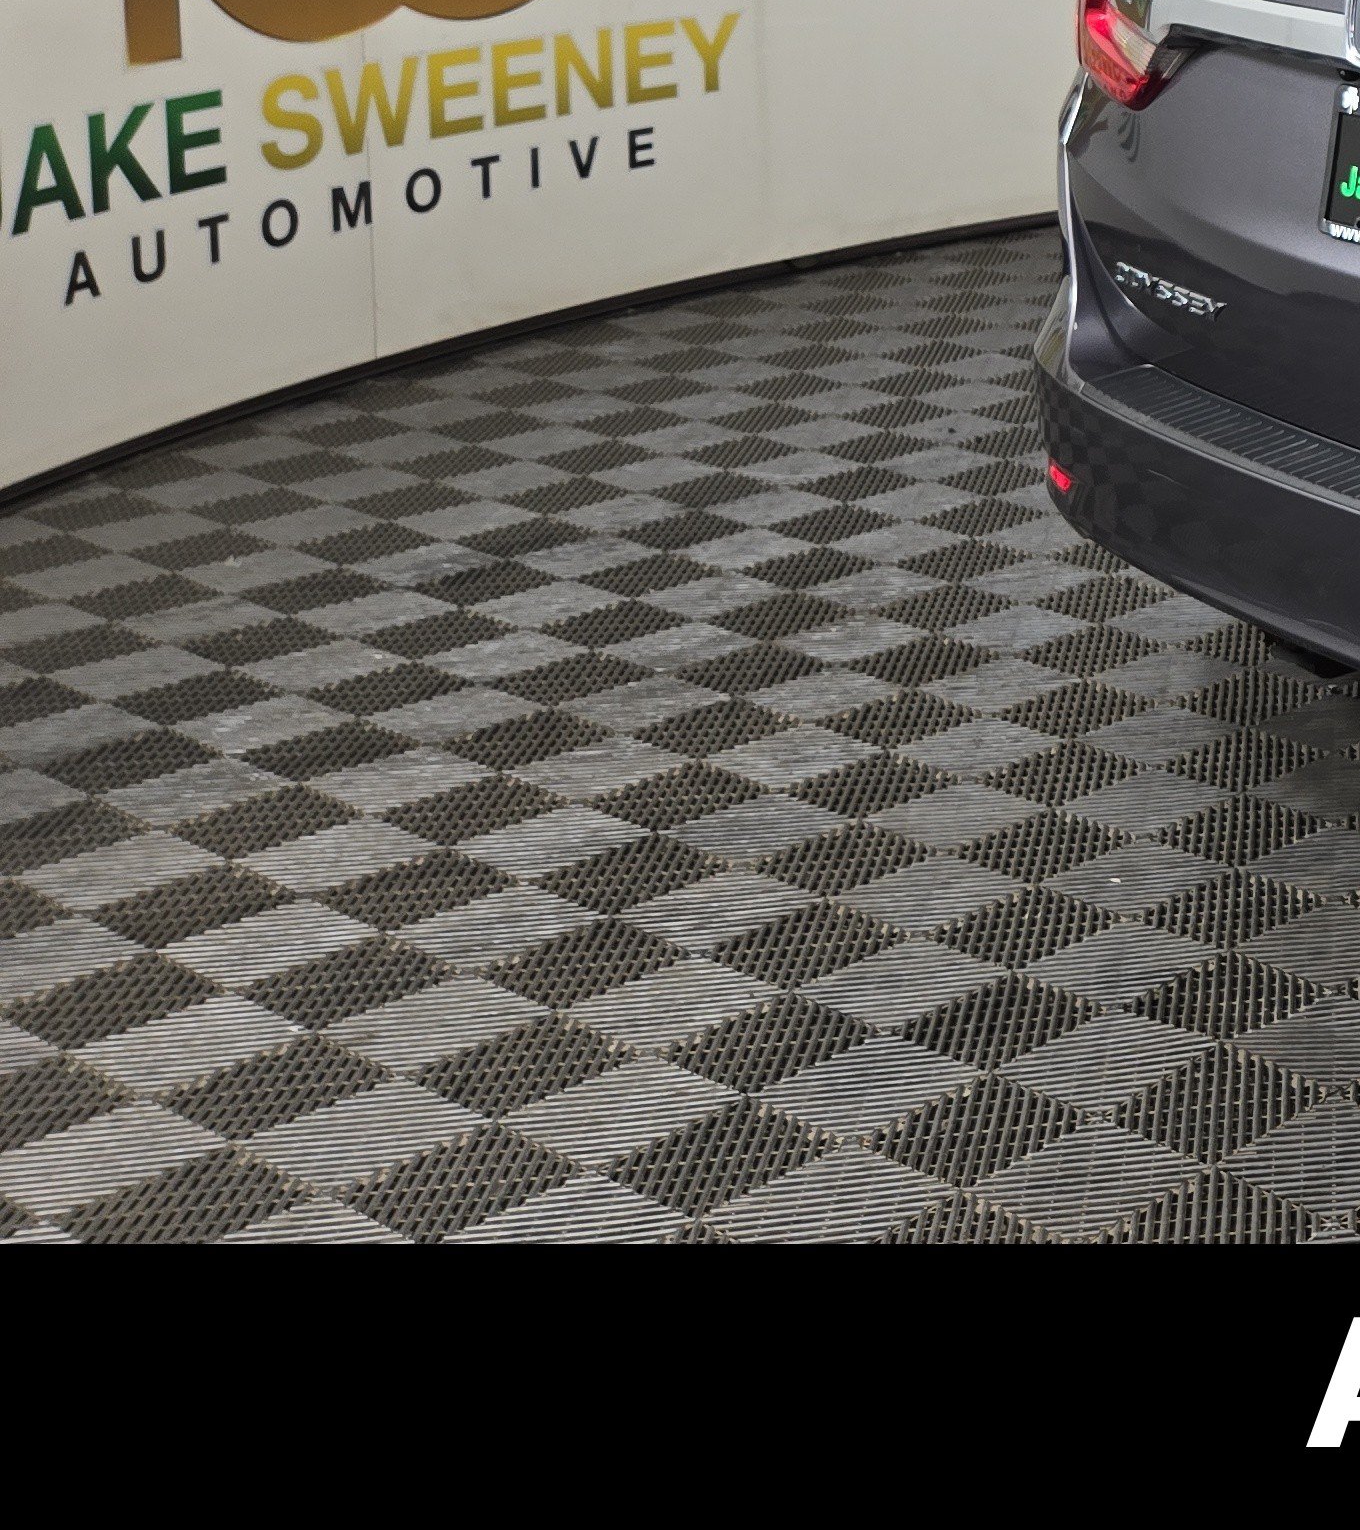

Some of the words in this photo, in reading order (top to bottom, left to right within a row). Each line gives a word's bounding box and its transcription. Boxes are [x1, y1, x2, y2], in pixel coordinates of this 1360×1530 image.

[0, 90, 228, 236] AKE
[260, 13, 741, 171] SWEENEY
[64, 127, 656, 306] AUTOMOTIVE
